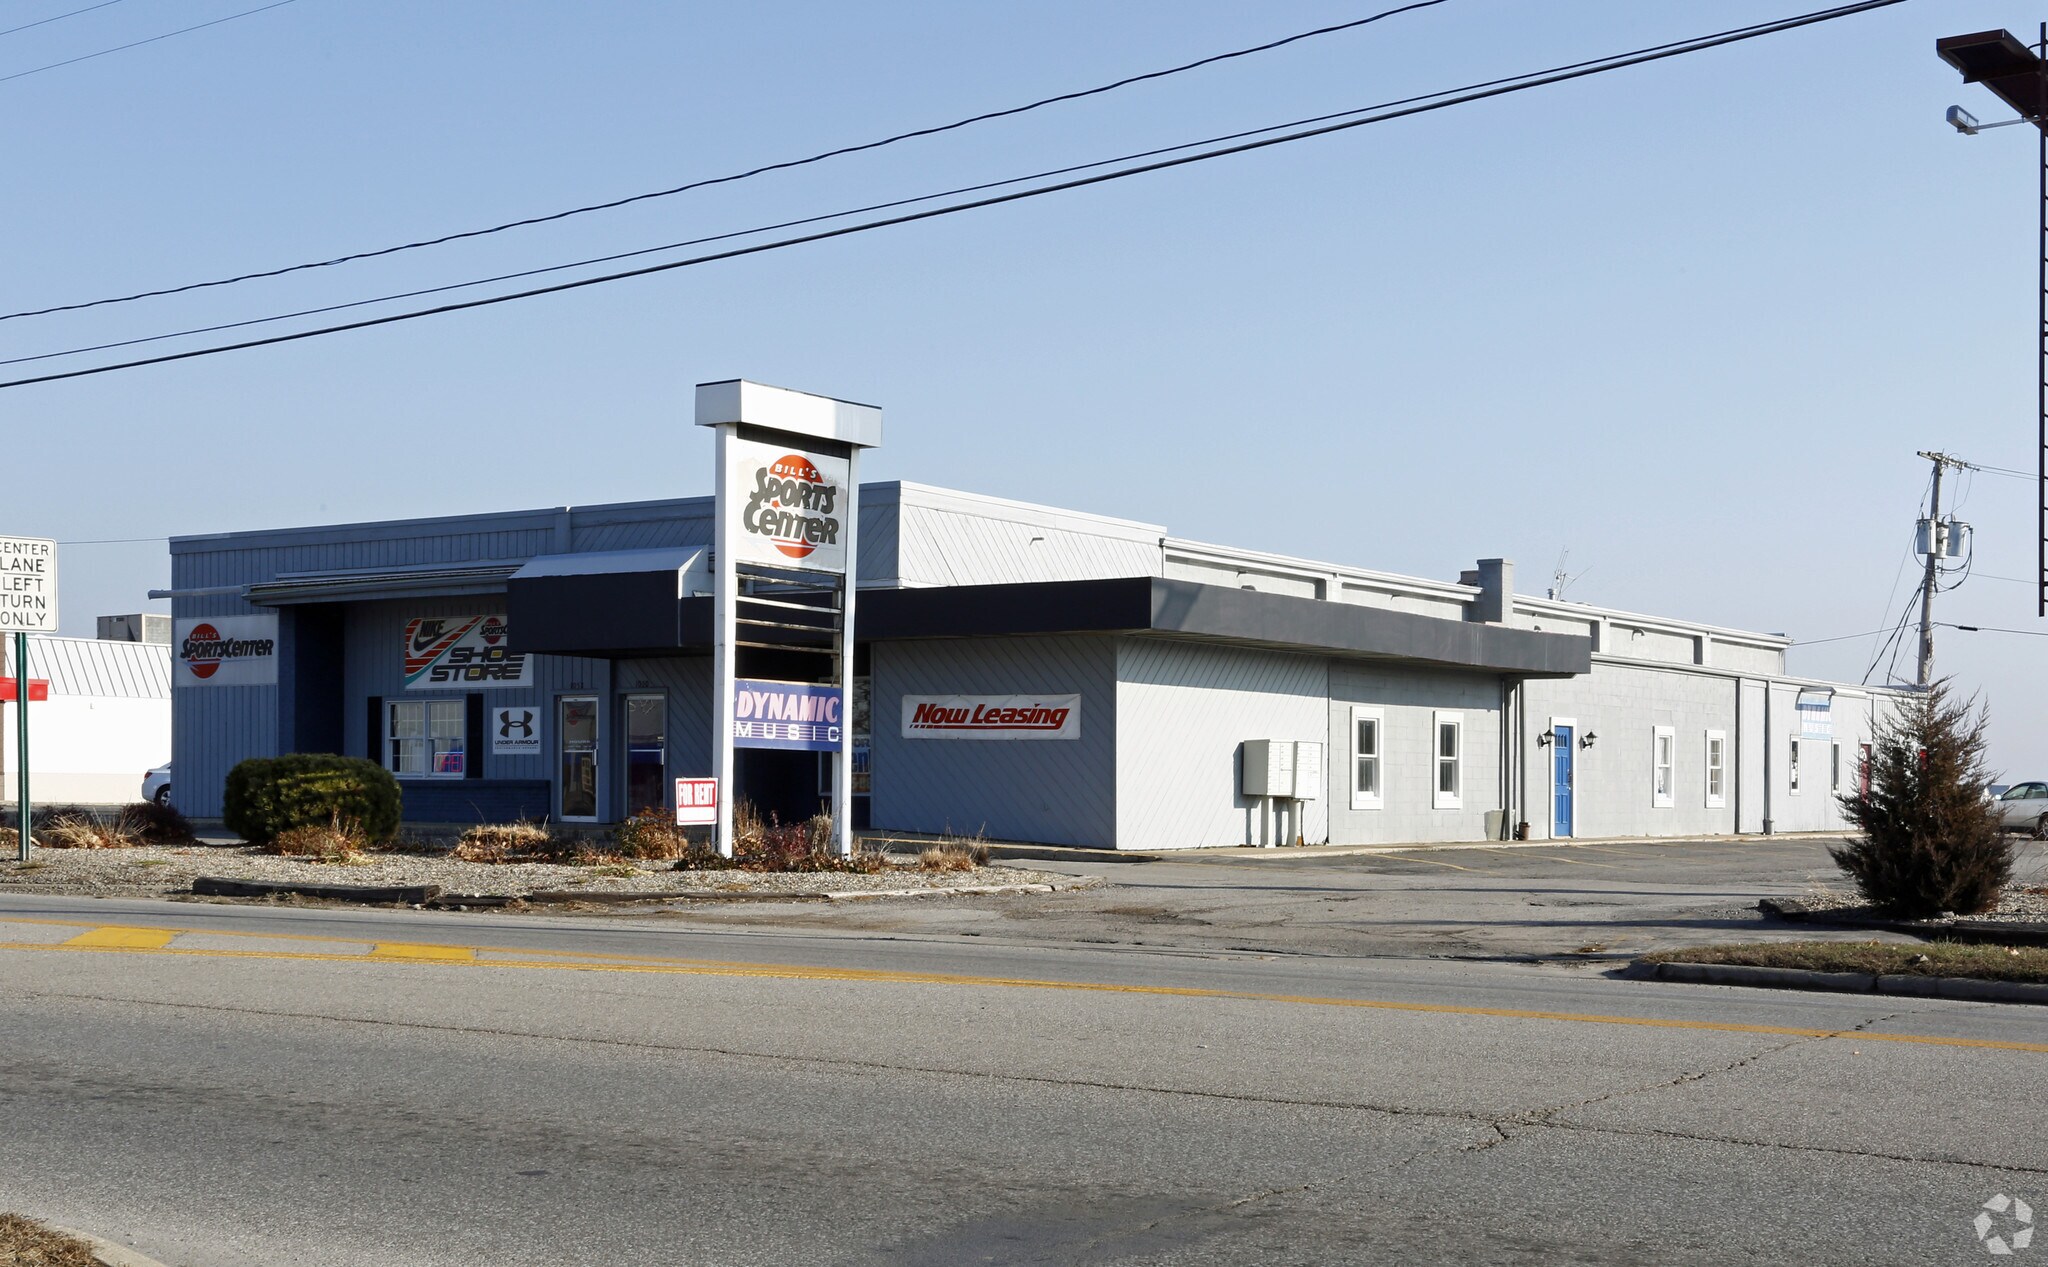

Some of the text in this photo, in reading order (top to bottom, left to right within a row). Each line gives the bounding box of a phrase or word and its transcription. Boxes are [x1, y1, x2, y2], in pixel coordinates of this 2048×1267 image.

[775, 463, 818, 479] BILL'S
[749, 467, 837, 514] SPORTS
[0, 541, 49, 556] ENTER
[0, 556, 46, 573] LANE
[3, 576, 44, 592] LEFT
[0, 593, 46, 609] TURN
[0, 611, 47, 626] ONLY
[192, 631, 217, 639] BILL'S
[419, 620, 446, 638] NIKE
[429, 662, 524, 682] STORE
[736, 690, 840, 723] DYNAMIC
[912, 703, 1069, 730] Now Leasing
[735, 720, 840, 742] MUSIC
[679, 783, 715, 806] FOR RENT
